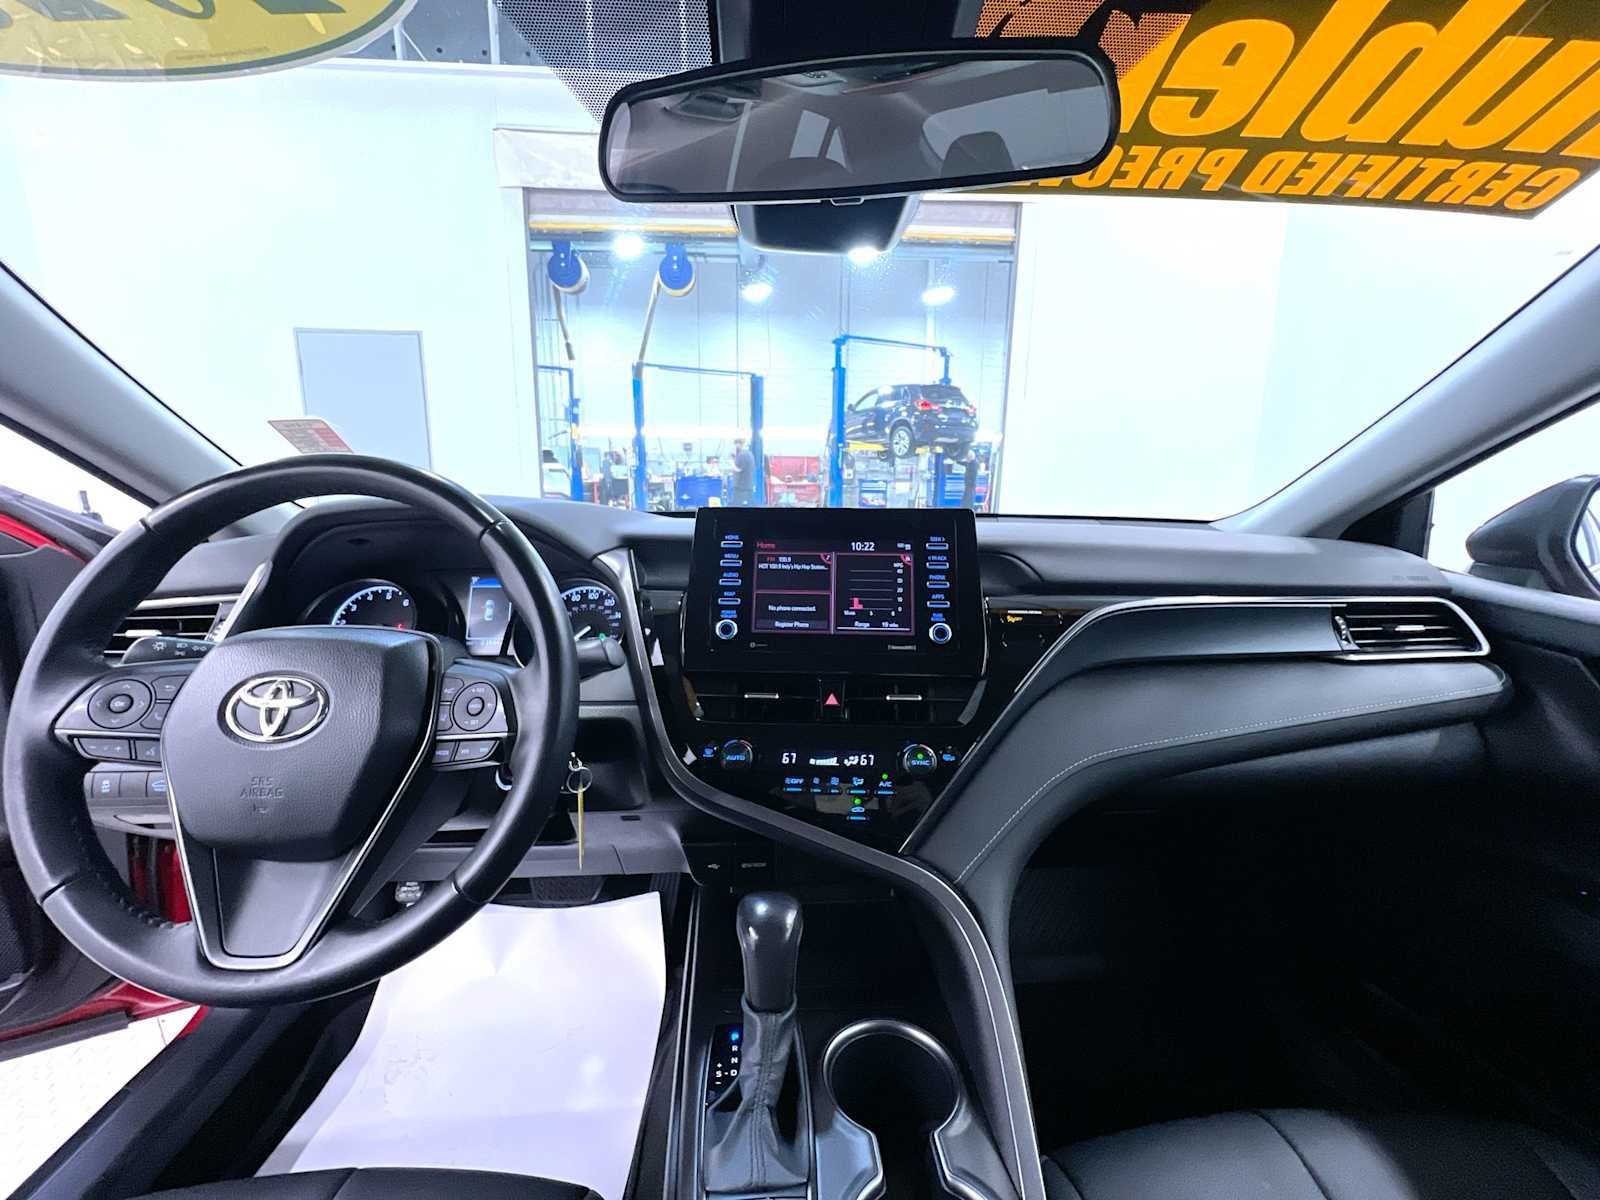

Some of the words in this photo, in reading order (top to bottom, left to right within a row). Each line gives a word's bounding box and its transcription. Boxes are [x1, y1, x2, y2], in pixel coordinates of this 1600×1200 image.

[851, 541, 875, 551] 10:22
[588, 592, 600, 600] 100
[782, 753, 797, 764] 67
[860, 754, 875, 766] 67
[239, 786, 284, 799] AIRBAG
[715, 1070, 723, 1078] S
